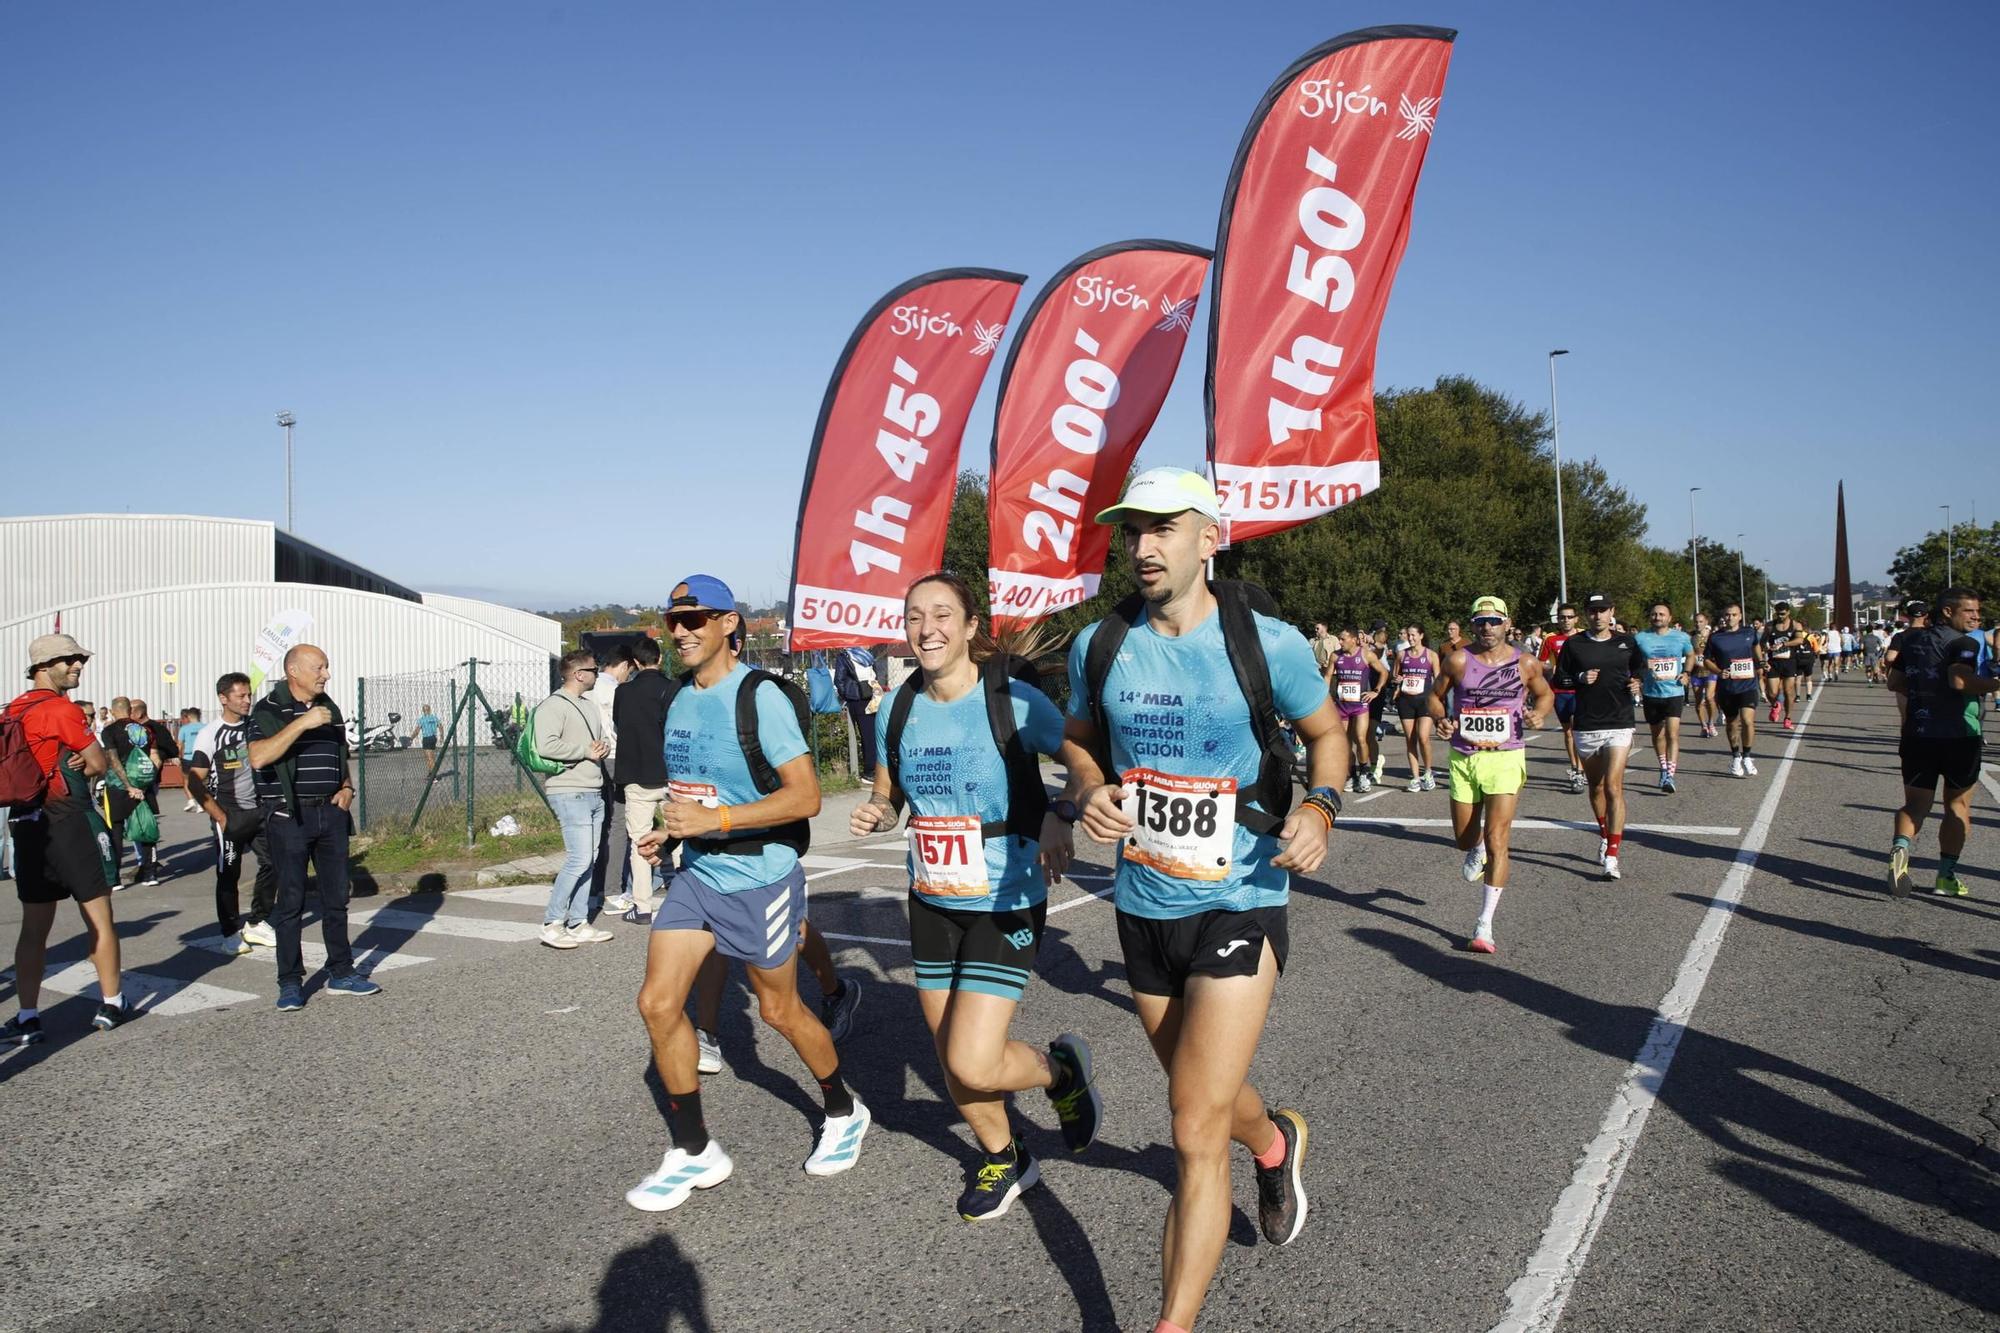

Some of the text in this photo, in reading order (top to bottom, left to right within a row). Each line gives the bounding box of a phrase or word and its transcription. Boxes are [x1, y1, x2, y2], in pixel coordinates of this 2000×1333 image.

[1299, 79, 1387, 124] gijón
[1073, 276, 1149, 313] gijón
[890, 305, 963, 340] gijón
[1267, 335, 1344, 446] 1h
[1022, 468, 1090, 563] 2h
[849, 495, 912, 576] 1h
[262, 627, 289, 650] EMULSA
[1654, 662, 1674, 672] 2167
[1142, 693, 1184, 707] MBA
[1133, 711, 1184, 726] media
[1464, 717, 1505, 732] 2088
[672, 728, 691, 739] MBA
[1121, 724, 1184, 740] maratón
[923, 746, 952, 756] MBA
[1134, 741, 1184, 758] GIJÓN
[916, 760, 952, 772] media
[905, 772, 951, 784] maratón
[916, 783, 952, 795] GIJÓN
[1136, 788, 1218, 838] 1388
[915, 832, 968, 866] 1571
